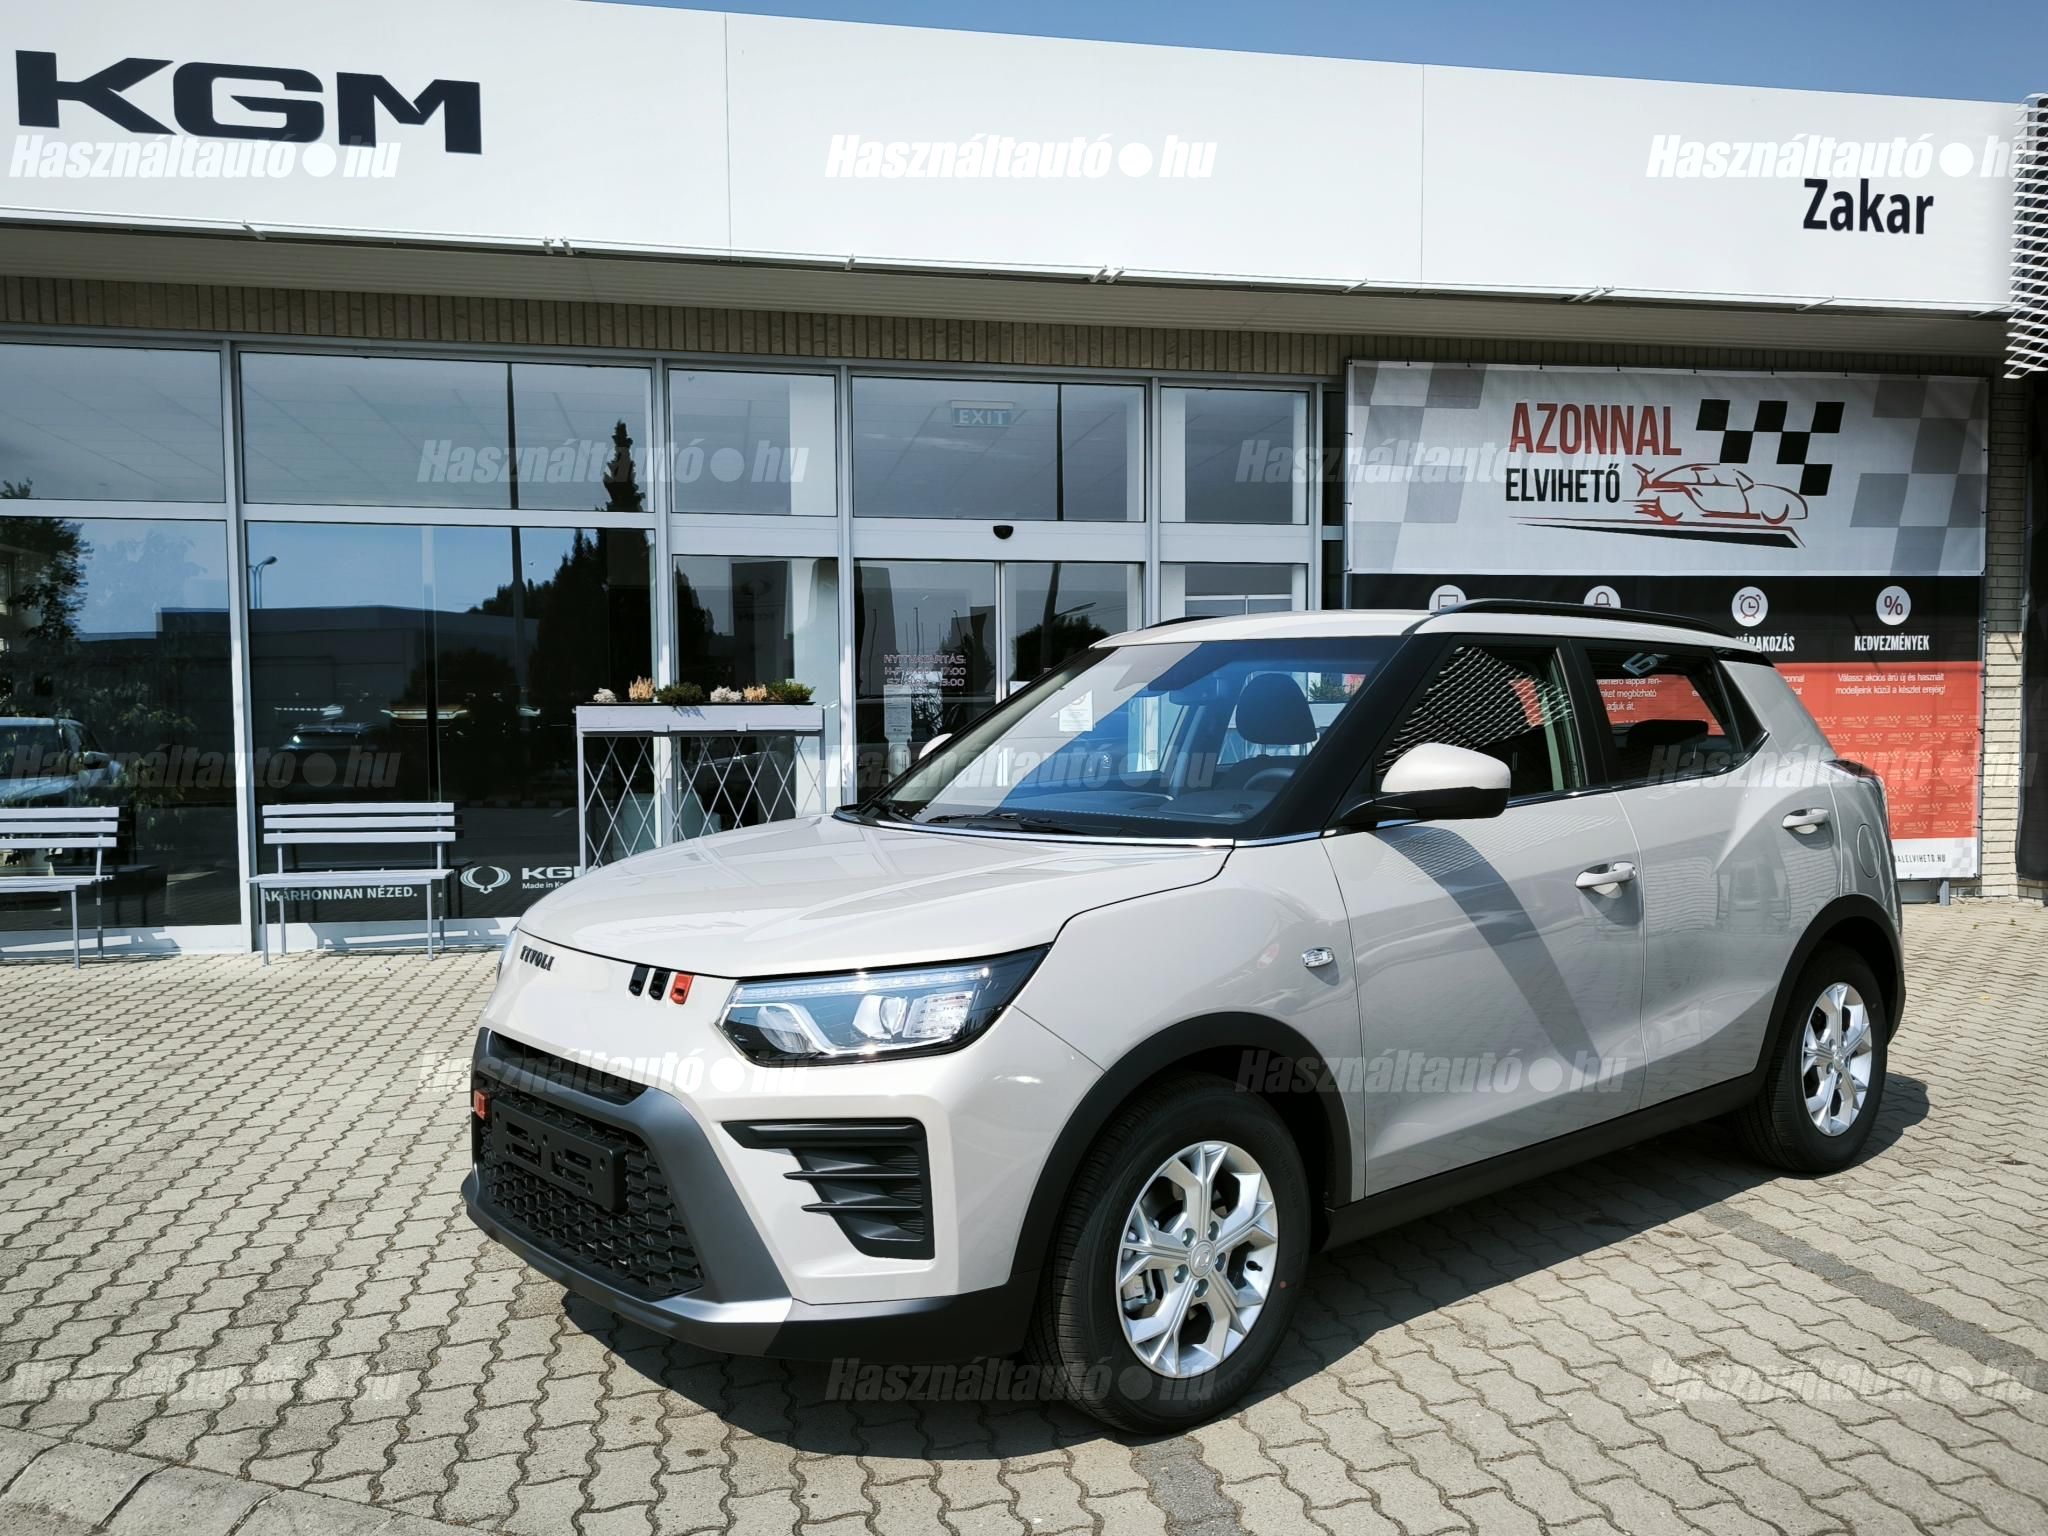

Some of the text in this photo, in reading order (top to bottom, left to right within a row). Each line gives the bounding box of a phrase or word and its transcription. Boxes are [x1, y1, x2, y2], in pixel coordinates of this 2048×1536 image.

[15, 50, 482, 154] KGM
[1802, 178, 1934, 235] Zakar
[958, 410, 1010, 425] EXIT
[1508, 401, 1682, 456] AZONNAL
[1505, 463, 1621, 503] ELVIHETŐ
[1854, 634, 1930, 651] KEDVEZMÉNYEK
[367, 885, 418, 898] NÉZED.
[522, 881, 545, 890] Made
[546, 881, 554, 889] in
